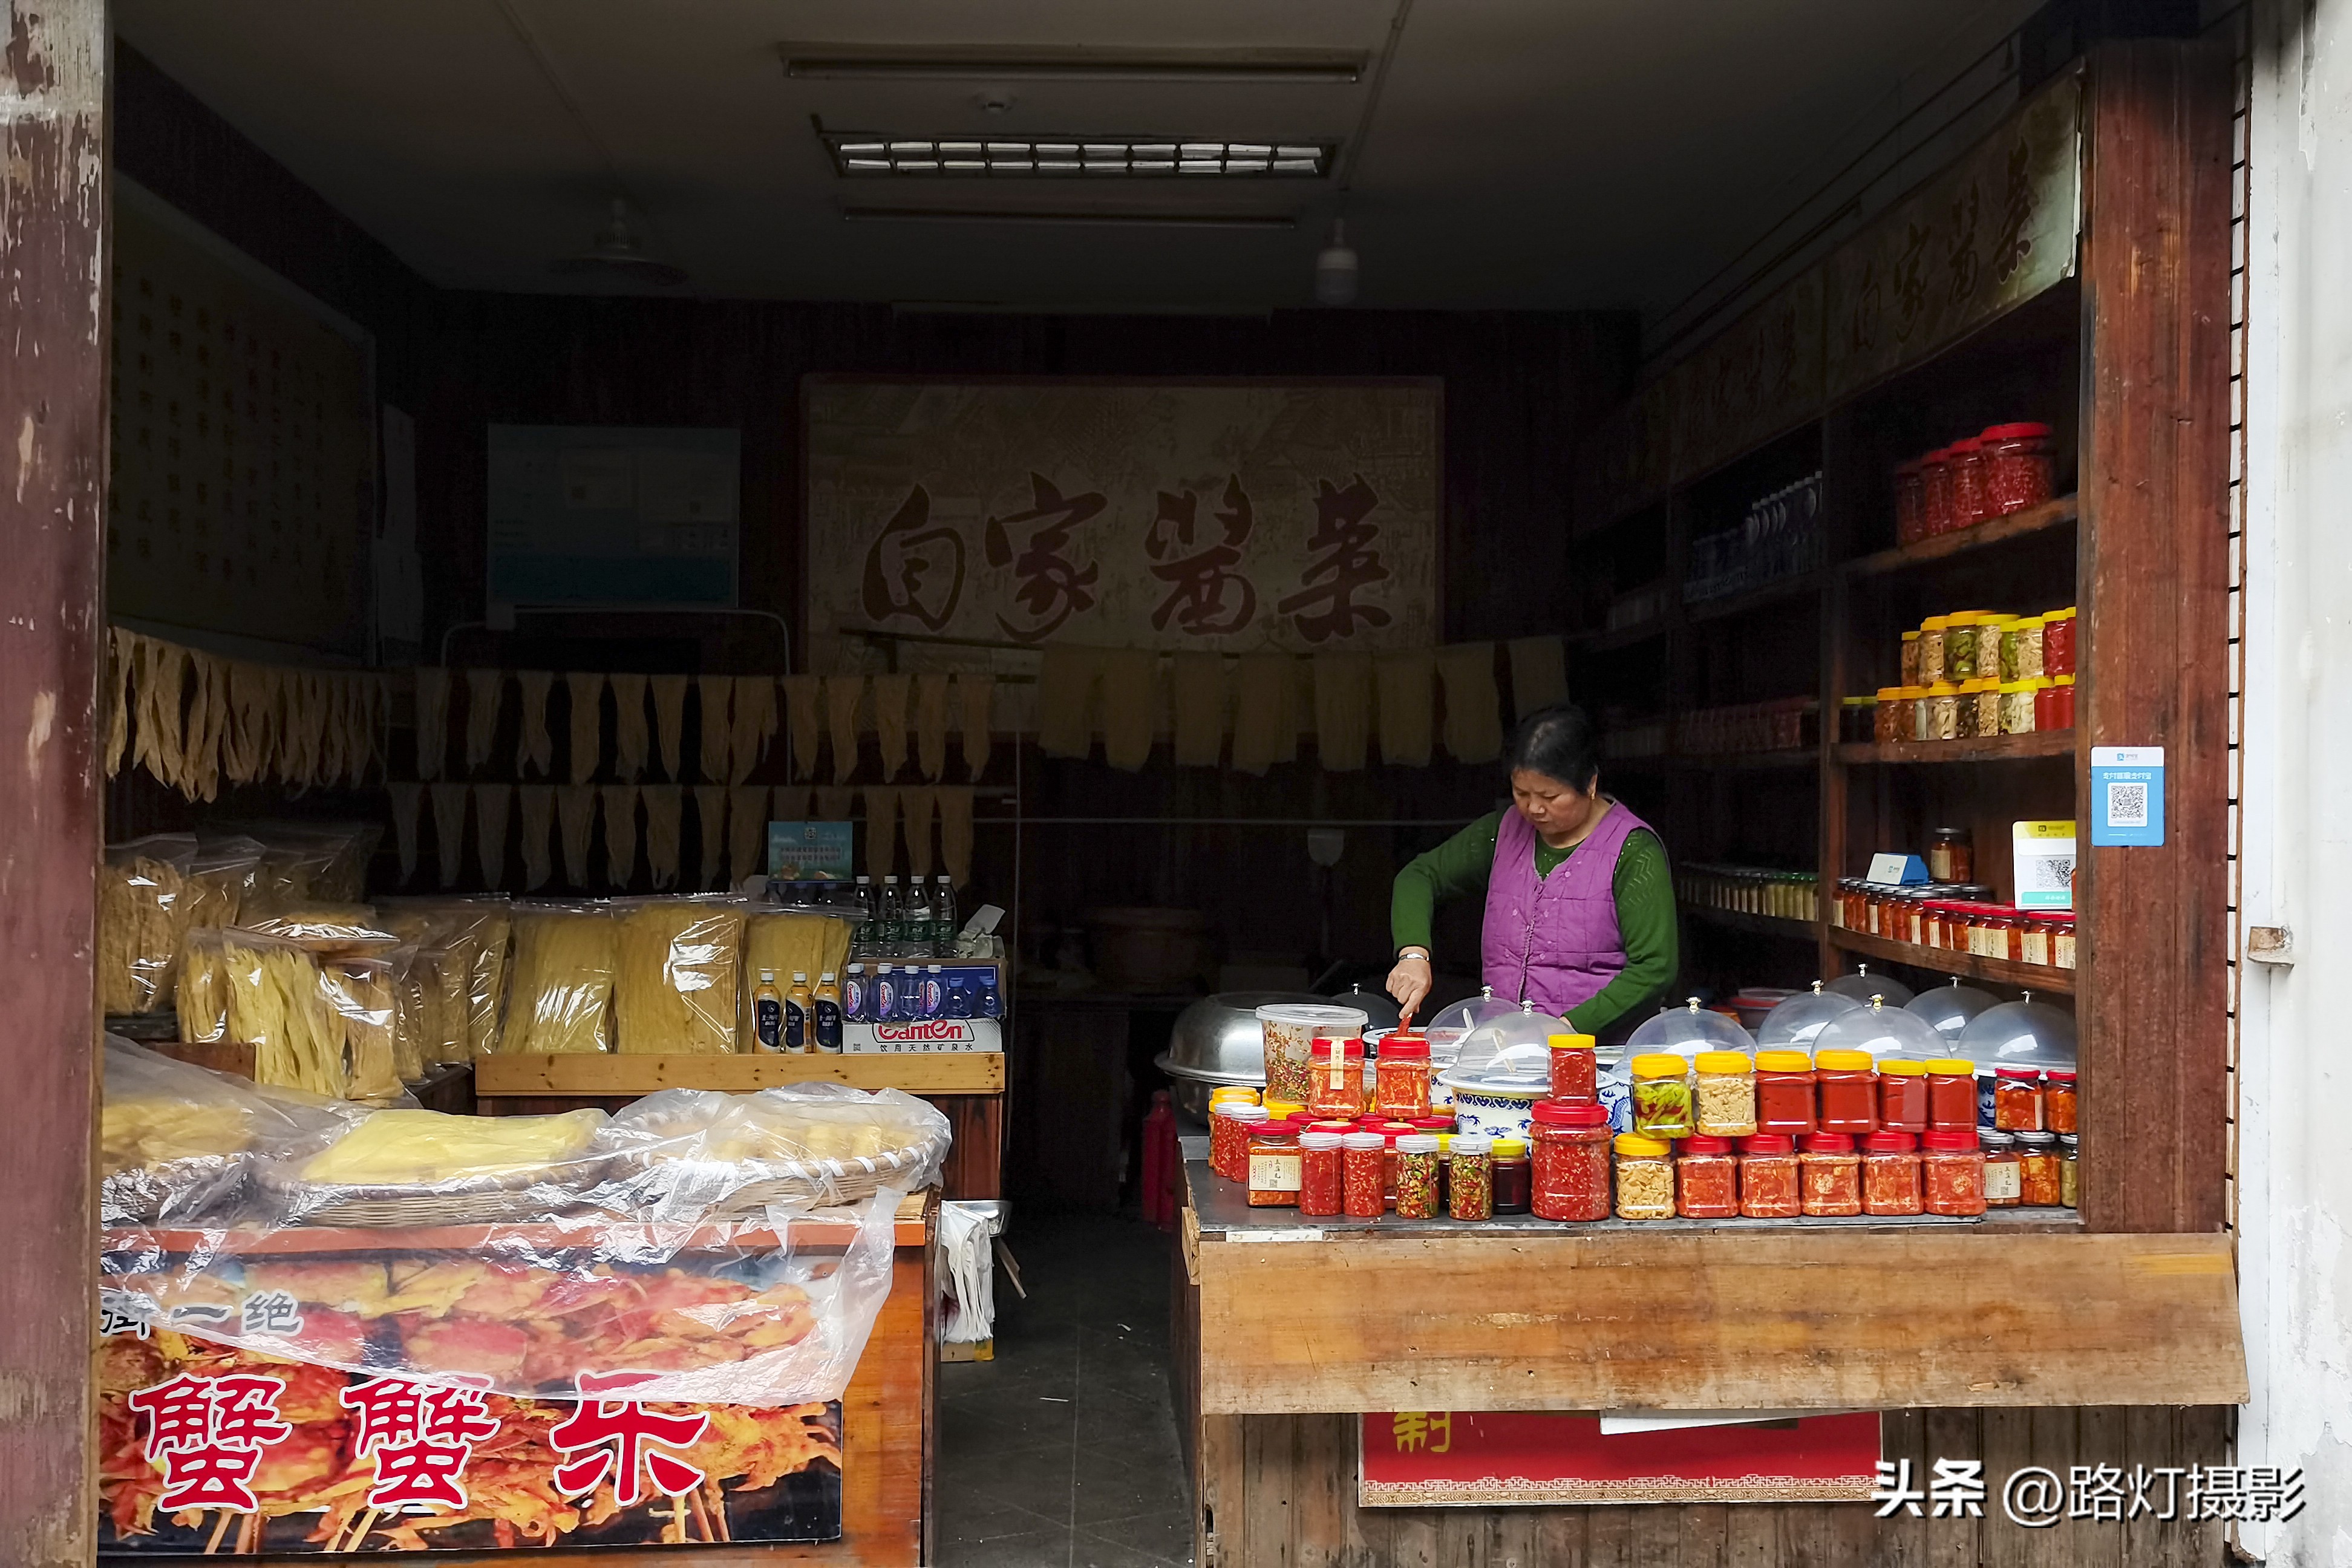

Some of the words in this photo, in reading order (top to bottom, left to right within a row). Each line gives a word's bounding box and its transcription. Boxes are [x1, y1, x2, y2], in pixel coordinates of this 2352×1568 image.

[880, 1043, 973, 1053] 饮用天然矿泉水
[128, 1368, 711, 1513] 蟹蟹乐
